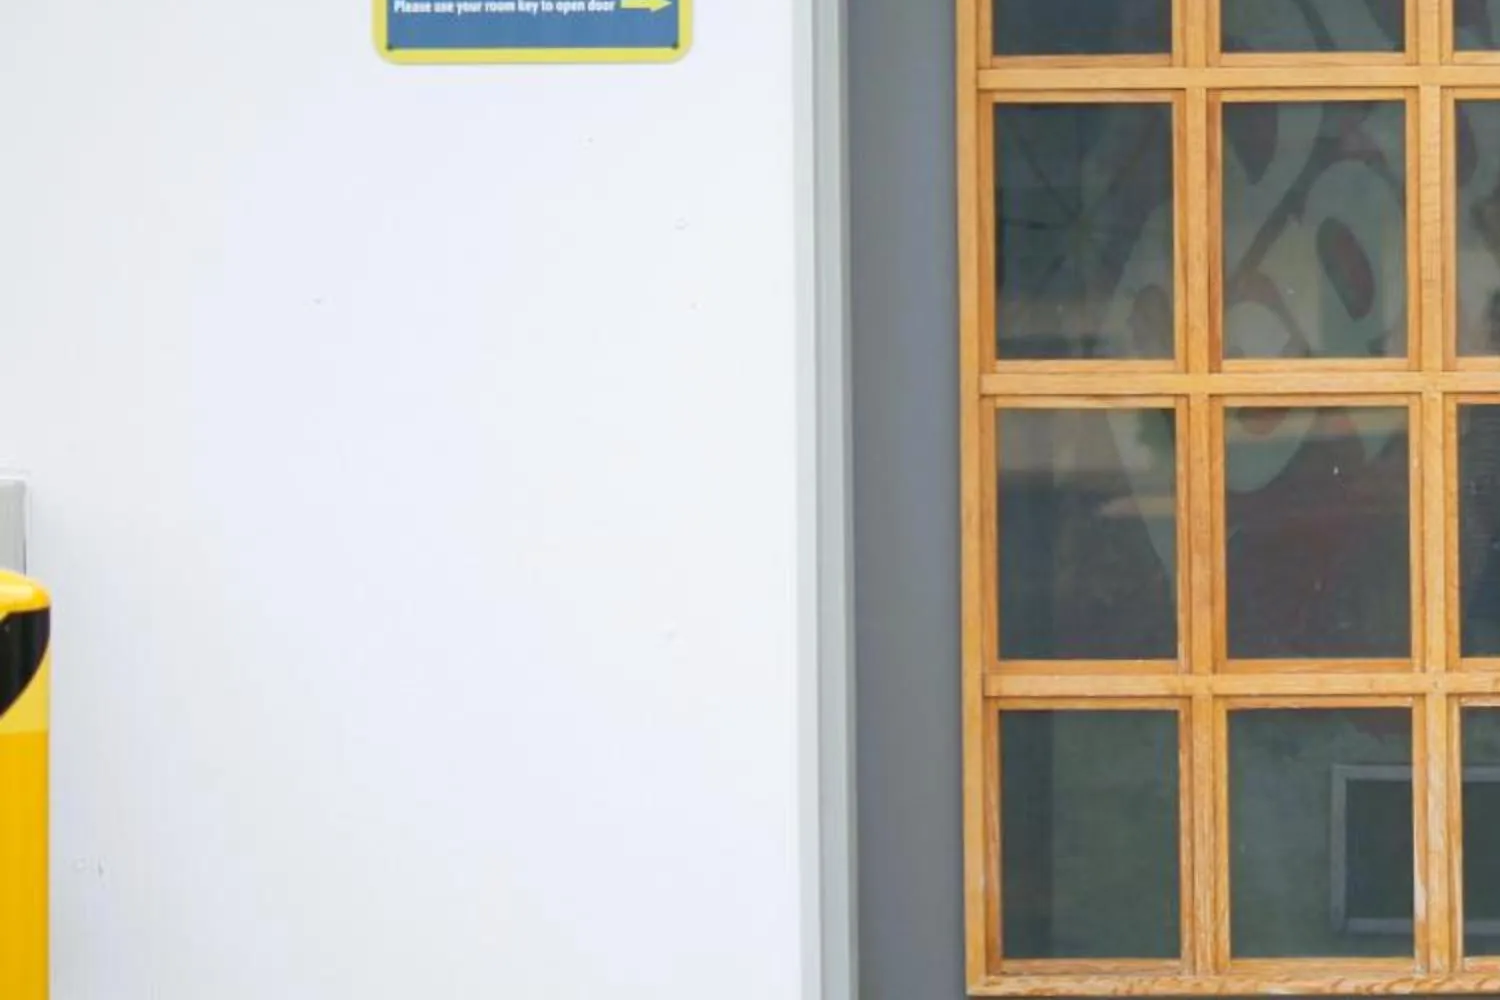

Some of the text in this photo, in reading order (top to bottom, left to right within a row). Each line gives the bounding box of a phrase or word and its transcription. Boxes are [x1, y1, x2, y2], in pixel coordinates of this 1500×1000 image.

[433, 1, 454, 13] use
[456, 1, 482, 16] your
[484, 1, 515, 13] room
[541, 0, 554, 12] to
[555, 0, 585, 15] open
